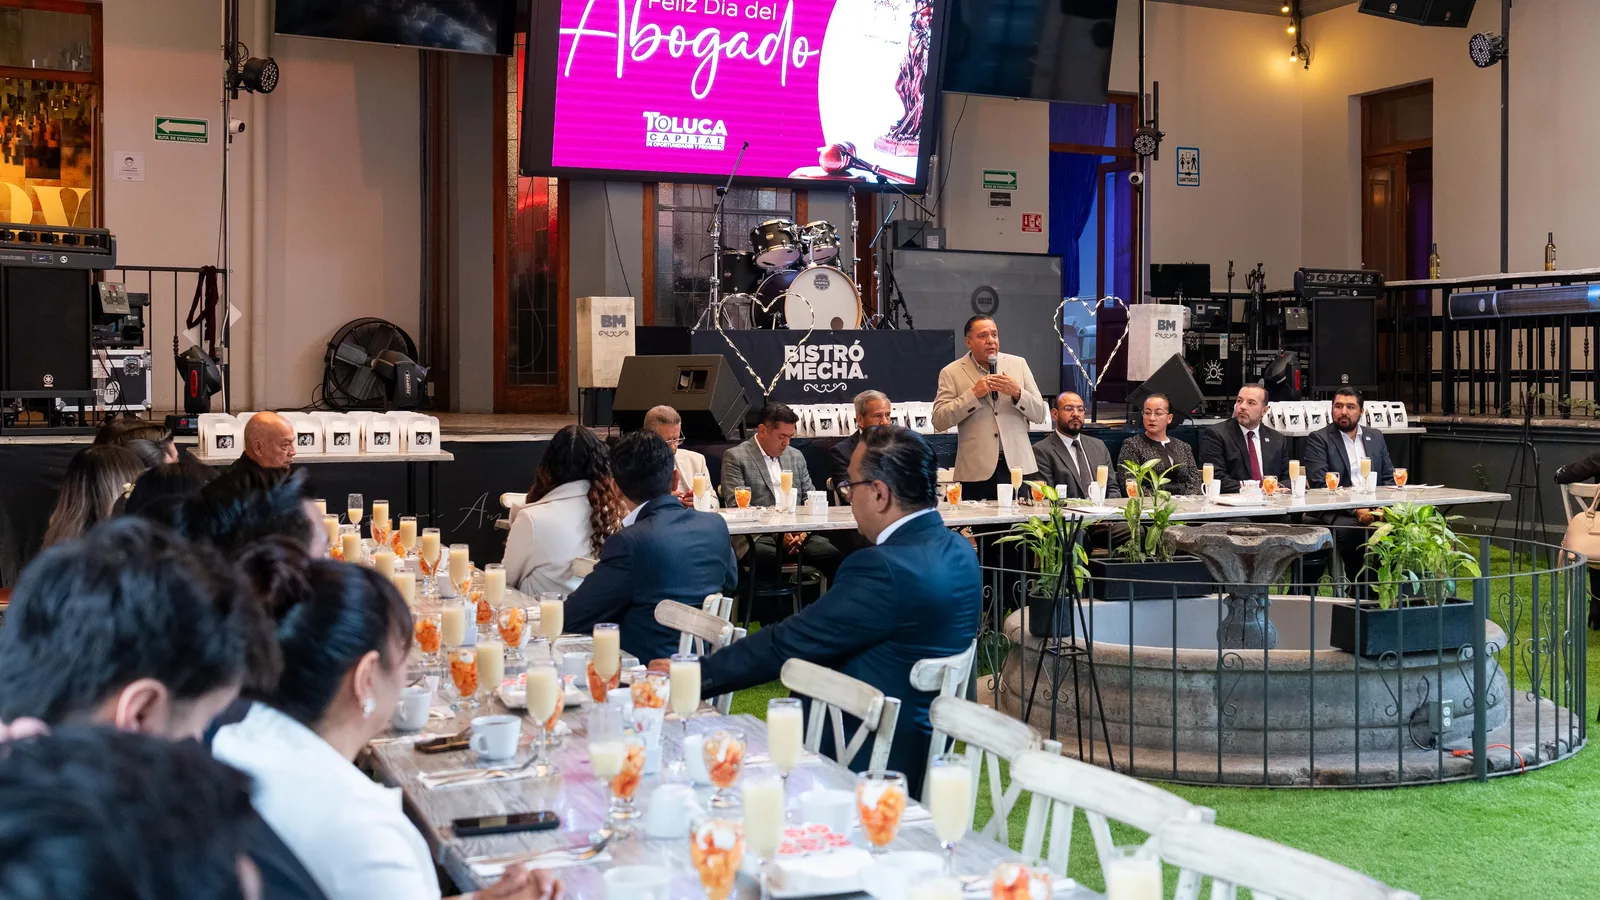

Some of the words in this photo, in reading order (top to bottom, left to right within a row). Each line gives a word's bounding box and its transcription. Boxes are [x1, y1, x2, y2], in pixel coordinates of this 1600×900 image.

[745, 1, 777, 20] del
[559, 0, 819, 99] Abogado
[643, 111, 728, 136] TOLUCA
[649, 133, 722, 145] CAPITAL
[601, 315, 626, 328] BM
[1157, 319, 1177, 331] BM
[784, 339, 865, 362] BISTRÓ
[784, 362, 864, 380] MECHA
